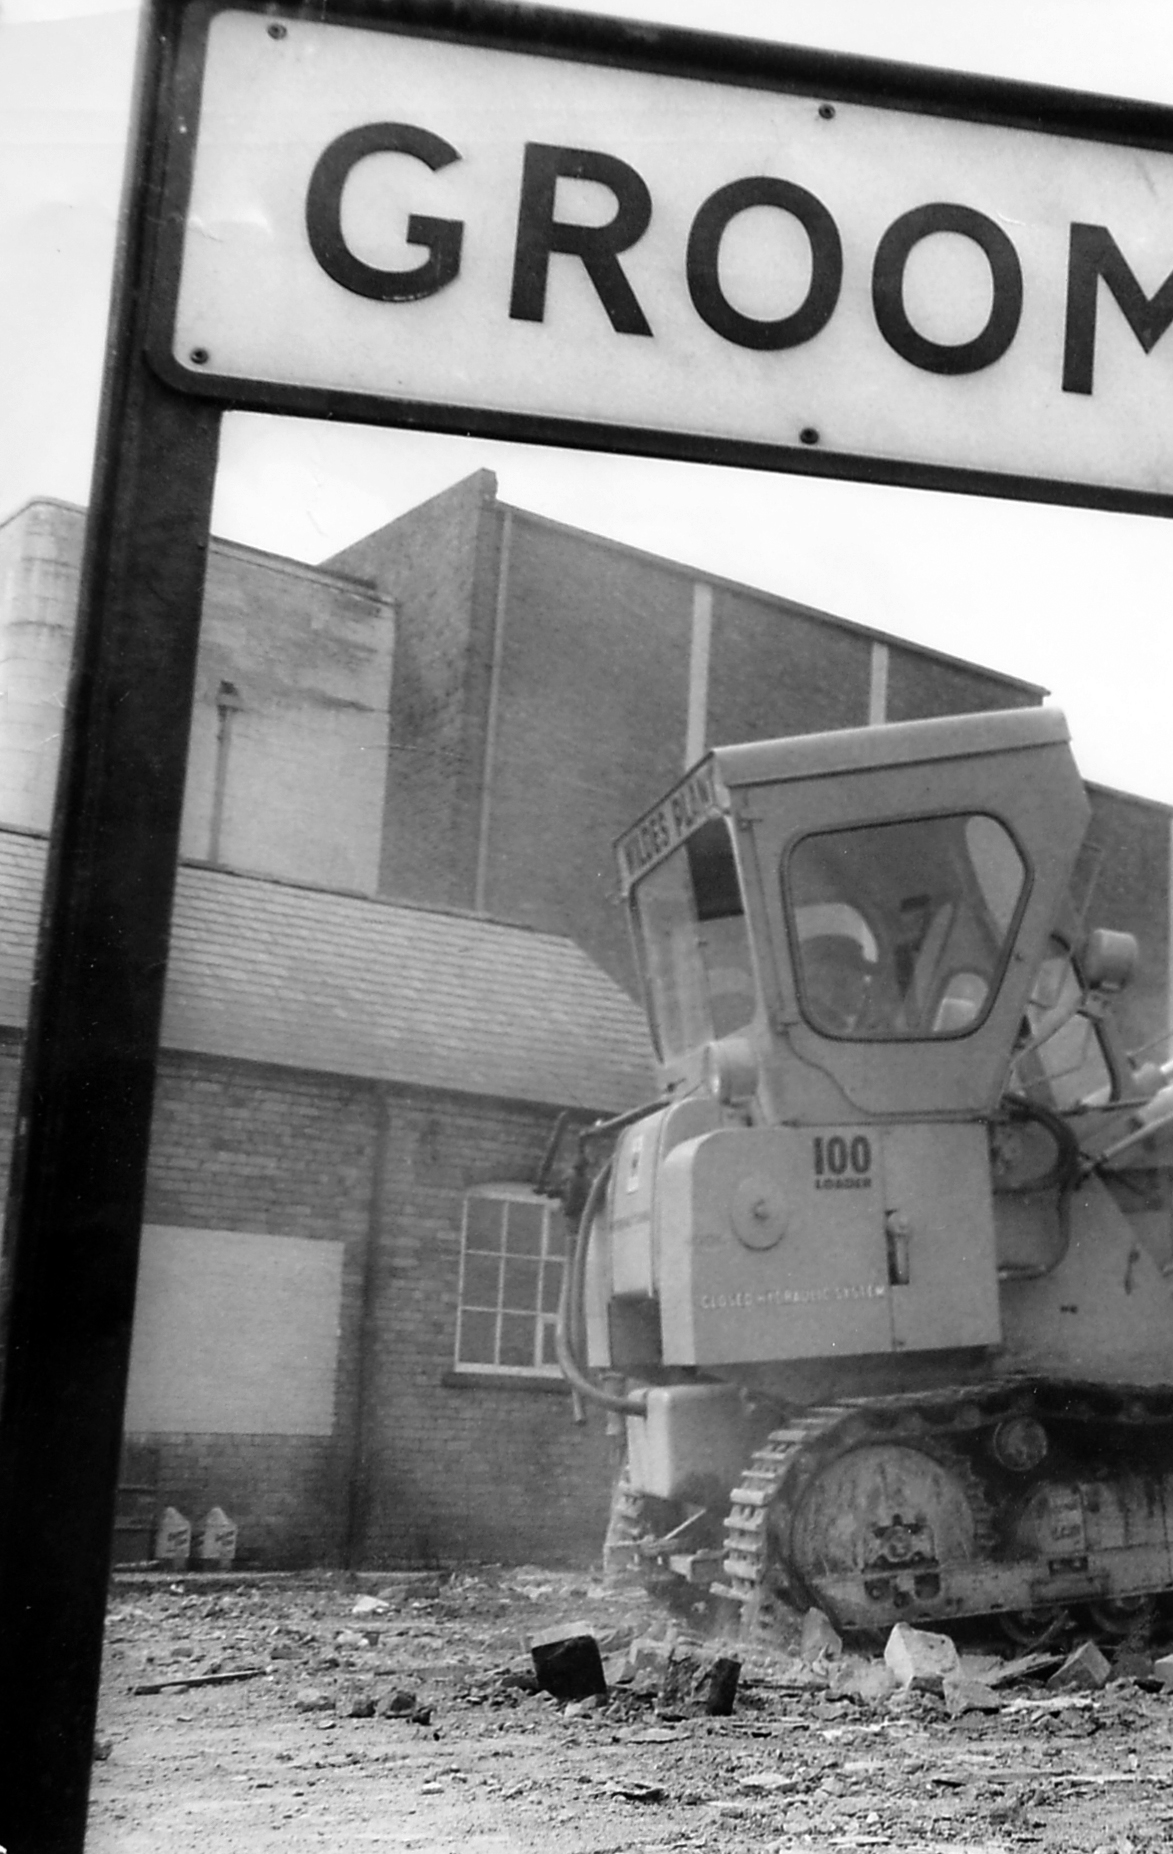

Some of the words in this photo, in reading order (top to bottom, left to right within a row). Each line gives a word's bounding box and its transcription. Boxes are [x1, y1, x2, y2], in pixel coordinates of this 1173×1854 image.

[813, 1135, 873, 1175] 100
[814, 1178, 872, 1190] LOADER
[700, 1292, 754, 1310] CLOSED
